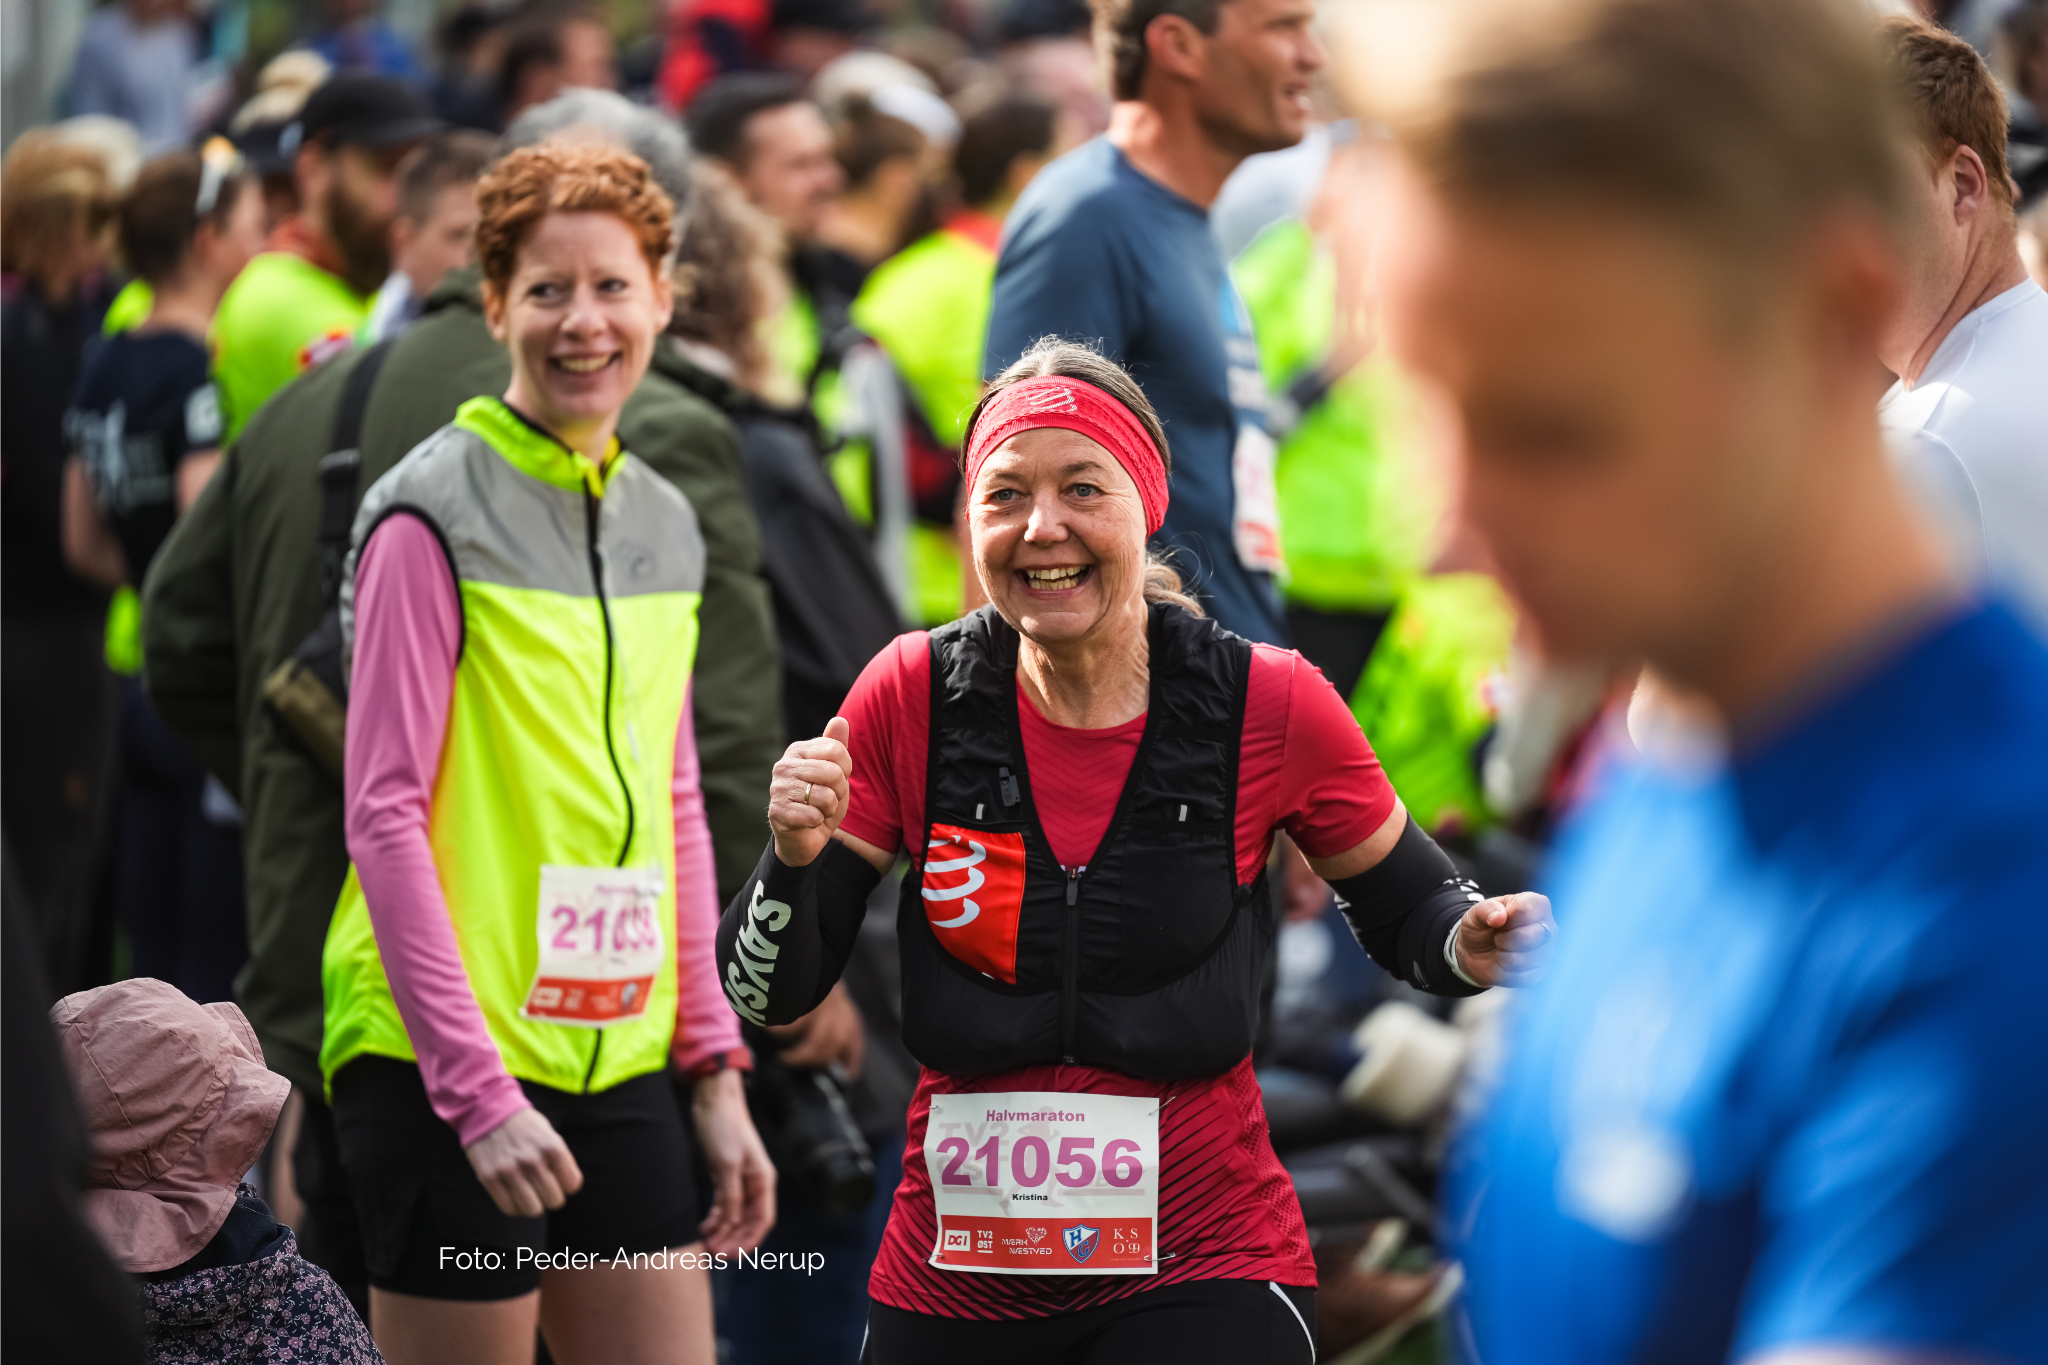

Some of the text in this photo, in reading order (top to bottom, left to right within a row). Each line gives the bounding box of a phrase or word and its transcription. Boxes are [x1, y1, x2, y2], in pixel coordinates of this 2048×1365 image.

[986, 1109, 1085, 1122] Halvmaraton
[936, 1135, 1143, 1188] 21056
[1012, 1193, 1048, 1201] Kristina
[977, 1230, 993, 1239] TV2
[947, 1234, 968, 1247] DGI
[977, 1240, 993, 1249] ØST
[1009, 1247, 1053, 1255] NÆSTVED
